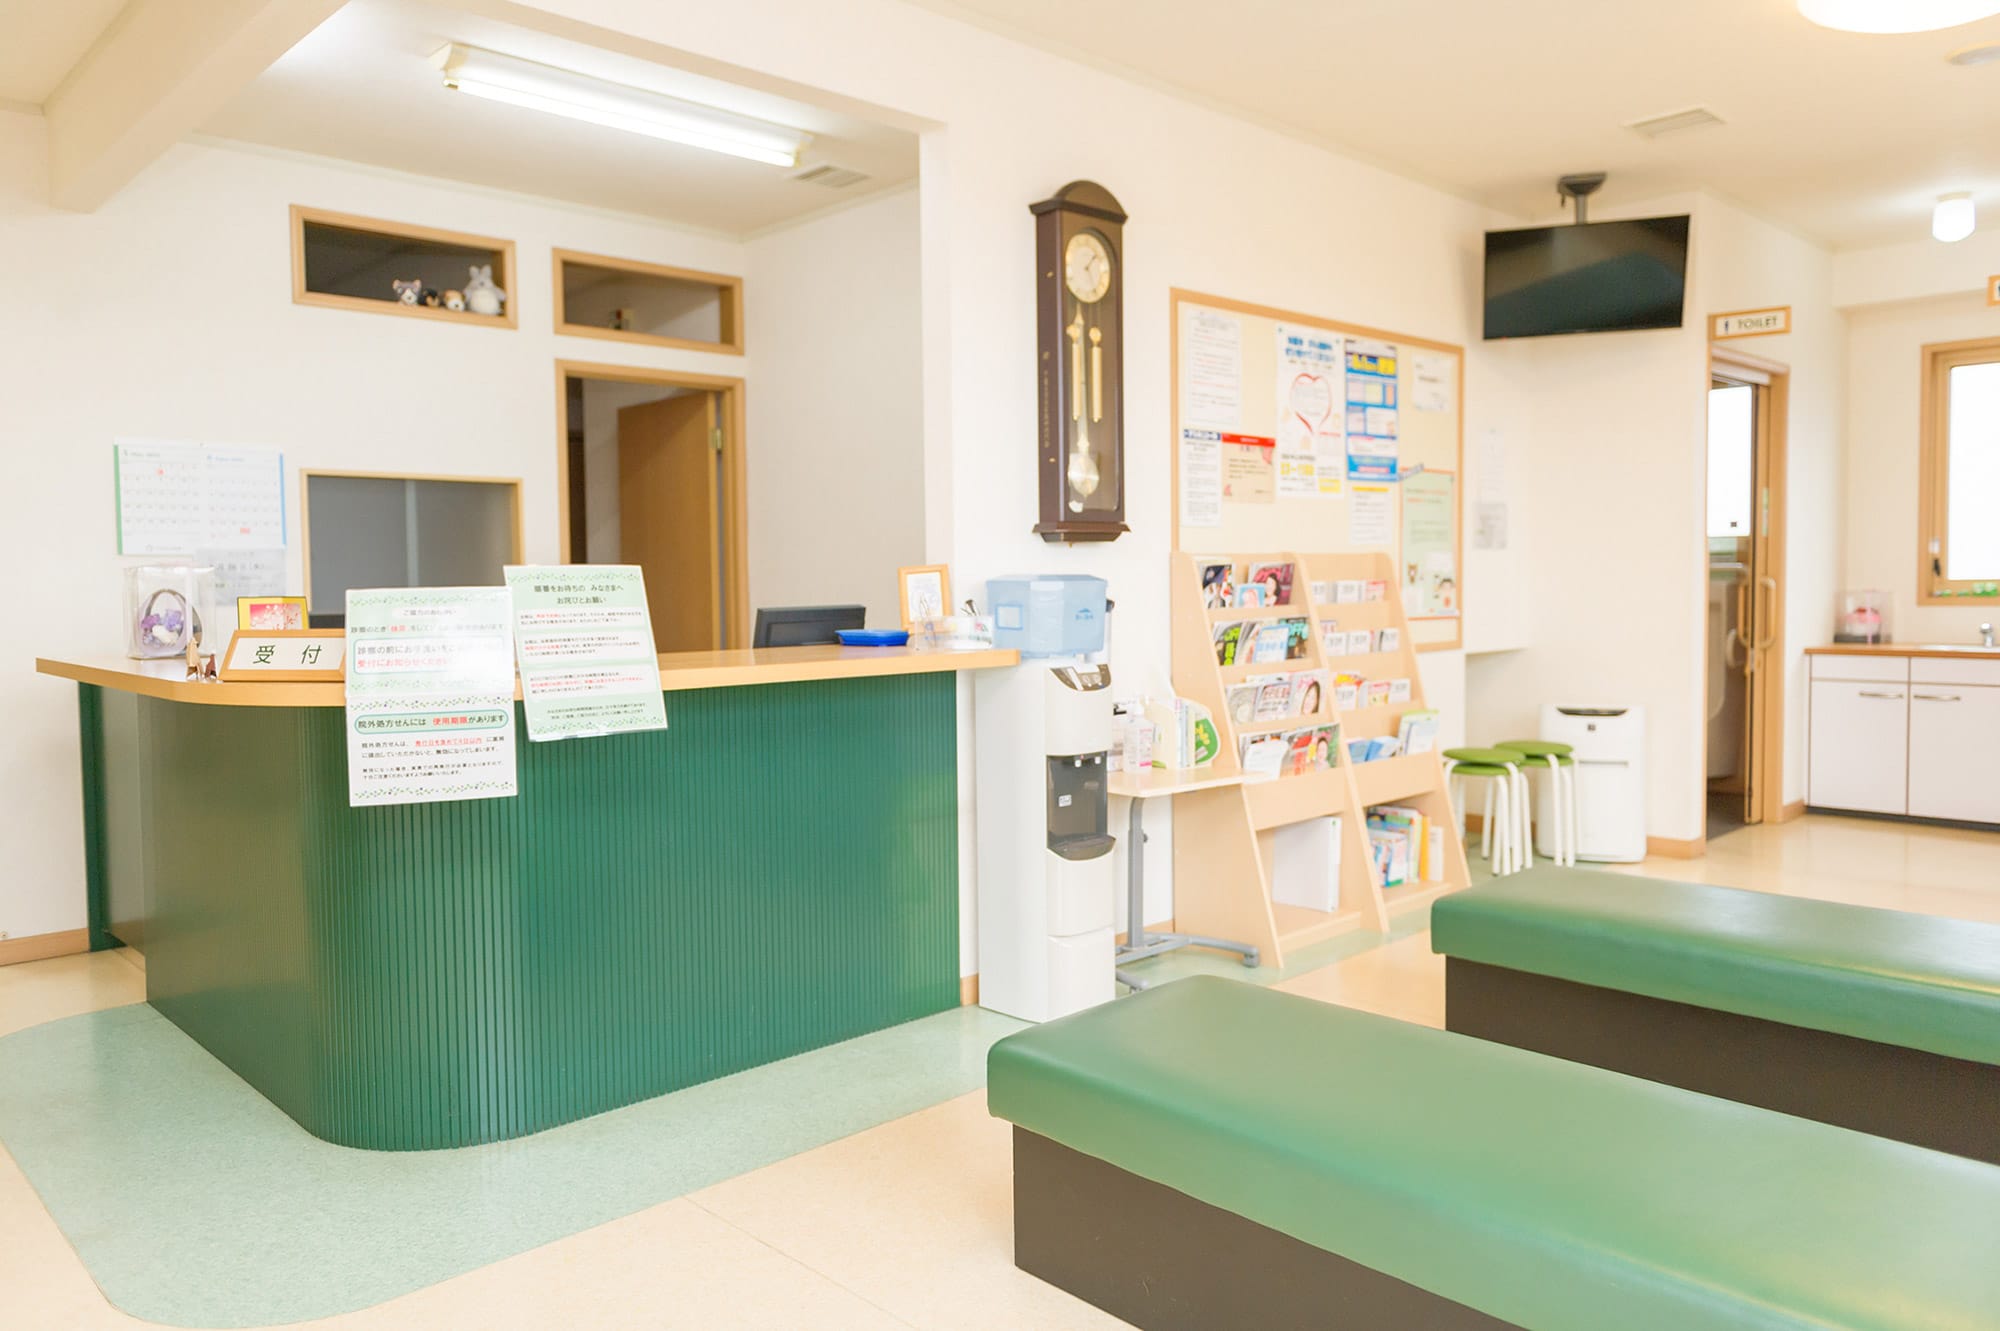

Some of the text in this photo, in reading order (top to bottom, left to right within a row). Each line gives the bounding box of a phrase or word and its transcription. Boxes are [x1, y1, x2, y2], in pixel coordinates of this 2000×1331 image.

[1738, 315, 1777, 329] TOILET
[591, 584, 624, 592] みなさまへ
[557, 596, 607, 605] お詫びとお願い
[252, 644, 323, 665] 受付
[358, 714, 505, 730] 院外処方せんには 使用期限があります
